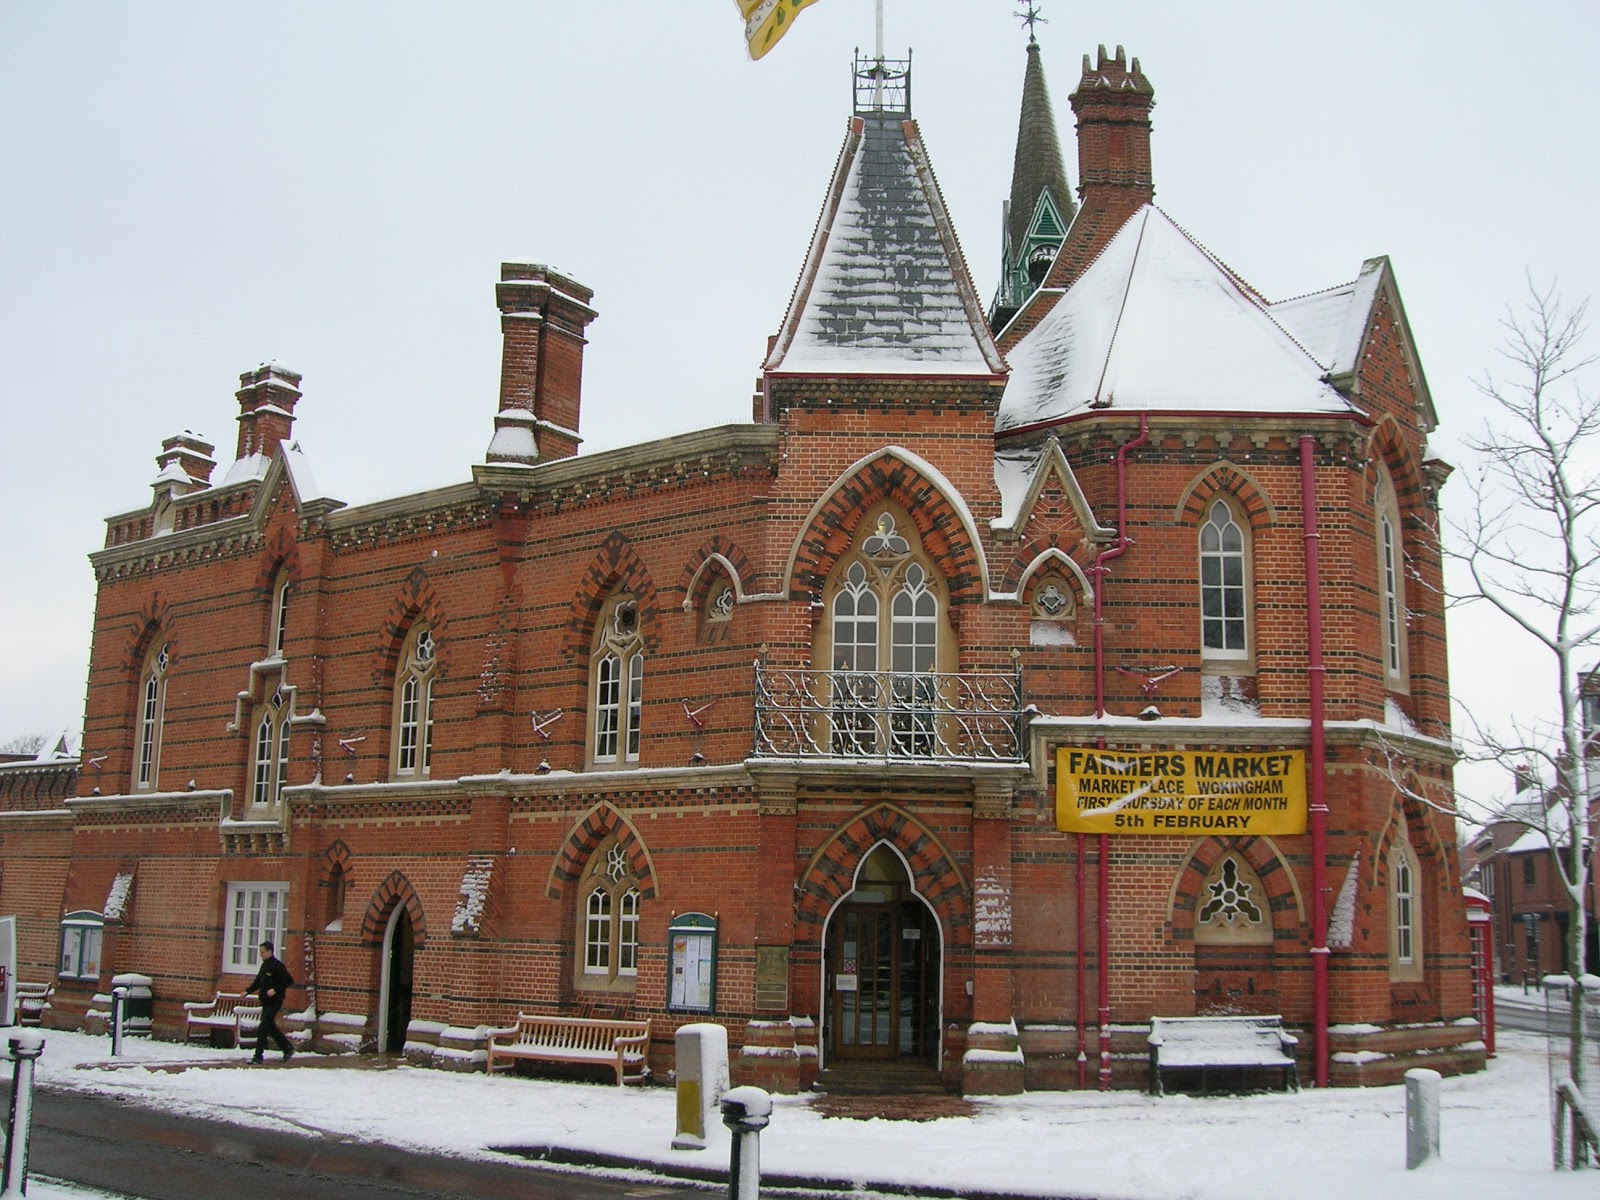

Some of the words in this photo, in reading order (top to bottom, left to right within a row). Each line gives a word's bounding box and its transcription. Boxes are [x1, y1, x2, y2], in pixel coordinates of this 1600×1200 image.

[1069, 752, 1186, 776] FARMERS
[1194, 755, 1292, 778] MARKET
[1079, 778, 1136, 793] MARKET
[1139, 780, 1184, 794] PLACE
[1197, 780, 1283, 795] WOKINGHAM
[1077, 796, 1112, 809] FIRST
[1117, 796, 1184, 810] HURSDAY
[1188, 798, 1204, 811] OF
[1208, 798, 1240, 811] EACH
[1243, 797, 1288, 810] MONTH
[1114, 814, 1145, 828] 5th
[1153, 815, 1251, 829] FEBRUARY
